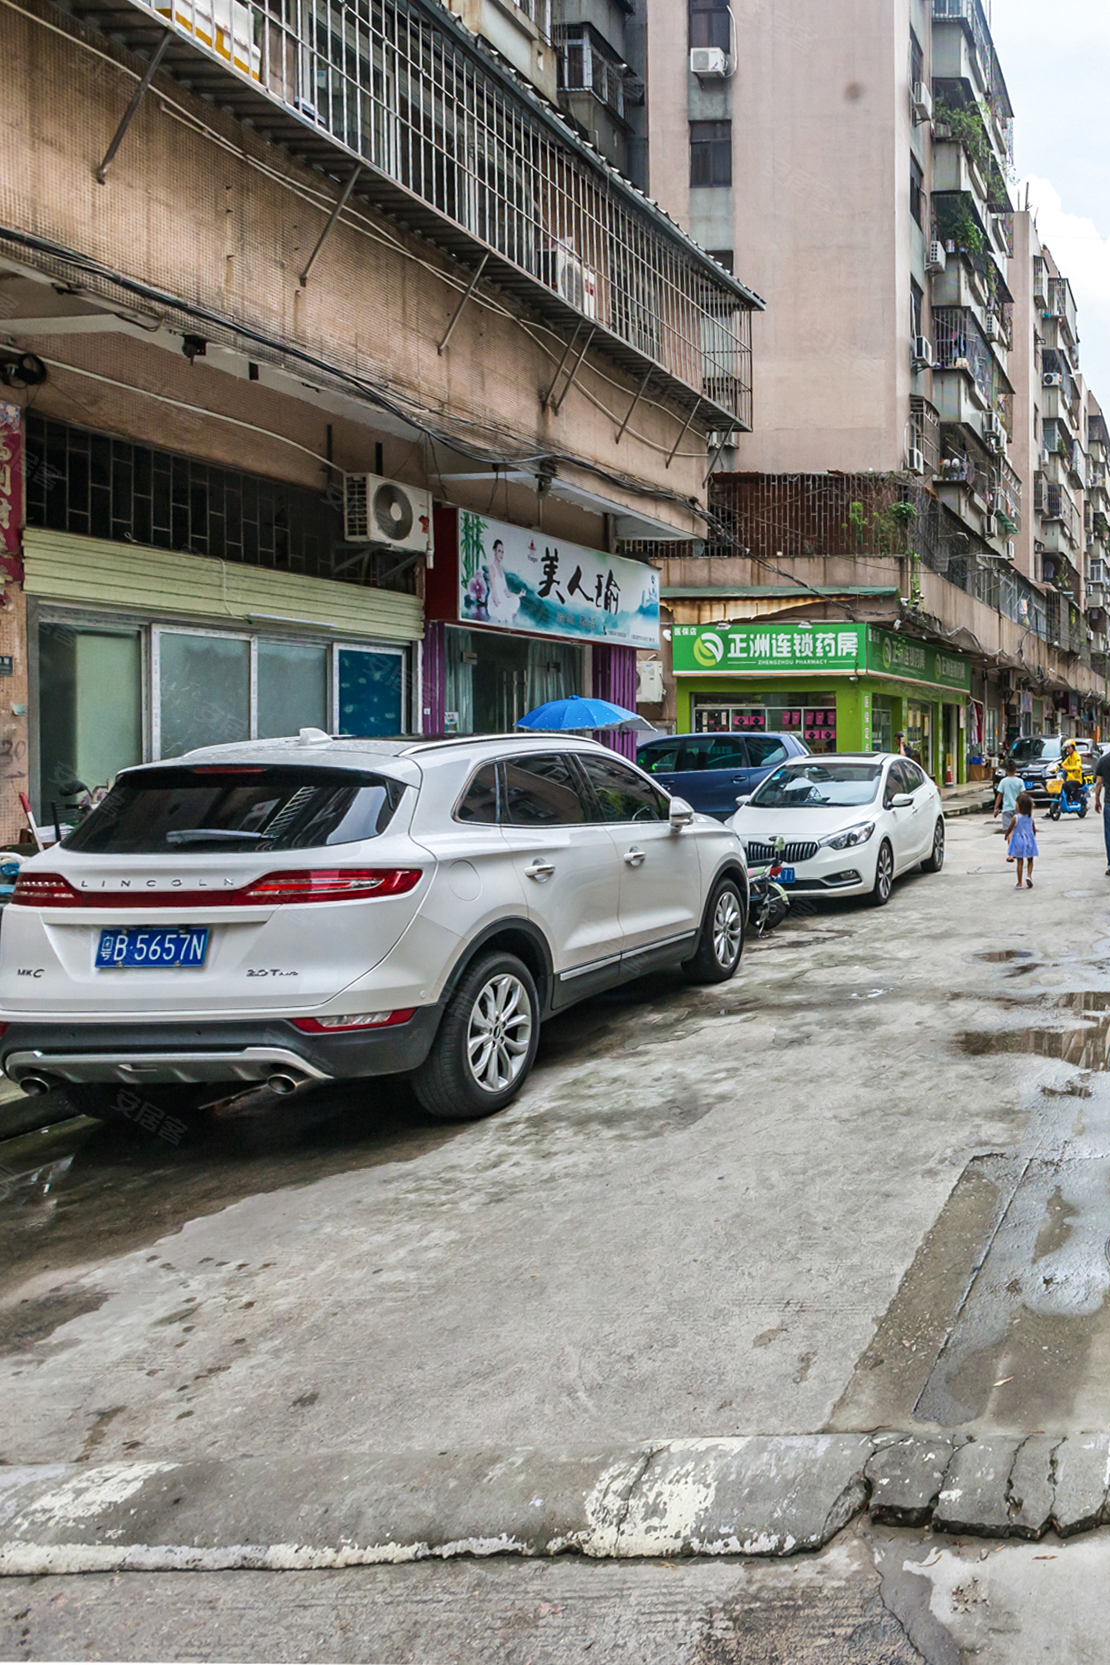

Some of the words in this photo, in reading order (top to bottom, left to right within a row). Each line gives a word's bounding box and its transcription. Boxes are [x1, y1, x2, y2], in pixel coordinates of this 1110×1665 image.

[674, 627, 697, 636] 医保店
[727, 632, 858, 658] 正洲连锁药房
[81, 878, 234, 888] LINCOLN
[17, 968, 45, 978] MKC
